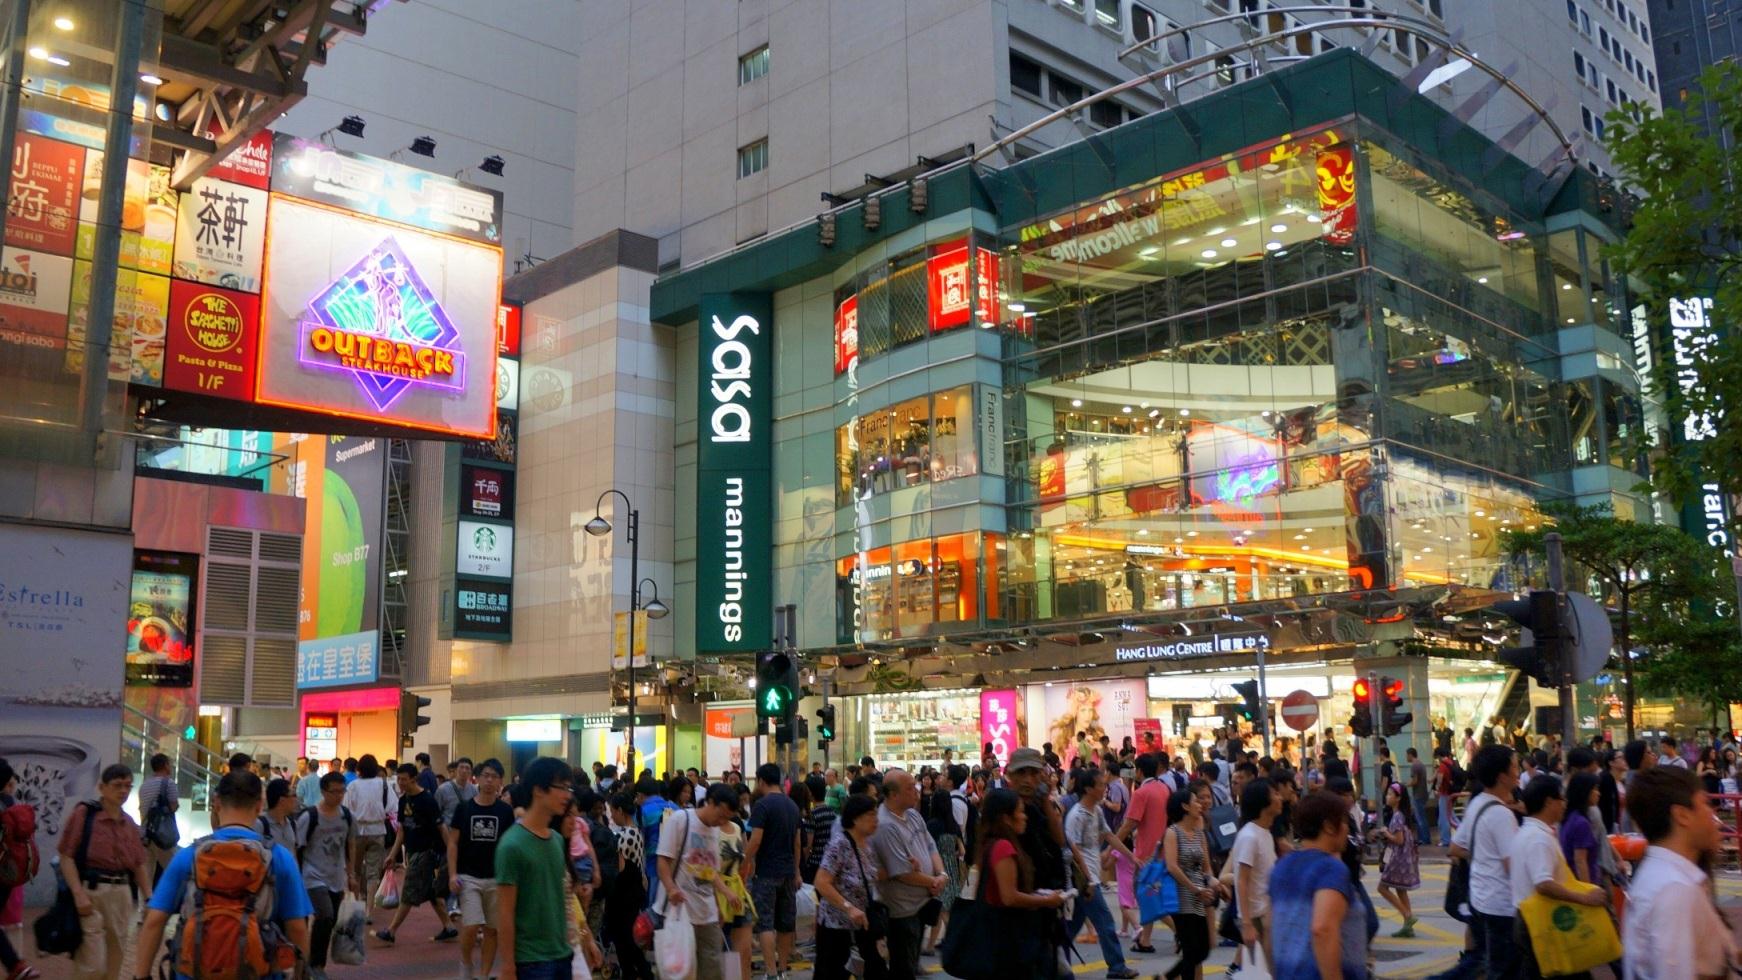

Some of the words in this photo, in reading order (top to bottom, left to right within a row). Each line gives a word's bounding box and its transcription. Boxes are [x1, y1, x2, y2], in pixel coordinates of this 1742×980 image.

[196, 185, 249, 252] 茶軒
[202, 296, 228, 314] THE
[198, 329, 231, 348] HOUSE
[178, 354, 206, 366] Pasta
[207, 359, 217, 368] &
[218, 360, 243, 372] Pizza
[311, 328, 455, 377] OUTBACK
[341, 356, 425, 380] STEAKHOUSE
[335, 438, 376, 463] Supermarket
[332, 551, 353, 568] Shop
[354, 543, 370, 562] B77
[468, 554, 501, 562] STARBUCKS
[719, 477, 748, 643] mannings
[478, 563, 490, 573] 2/F
[1116, 647, 1145, 661] HANG
[1146, 644, 1175, 658] LUNG
[1176, 641, 1213, 656] CENTRE
